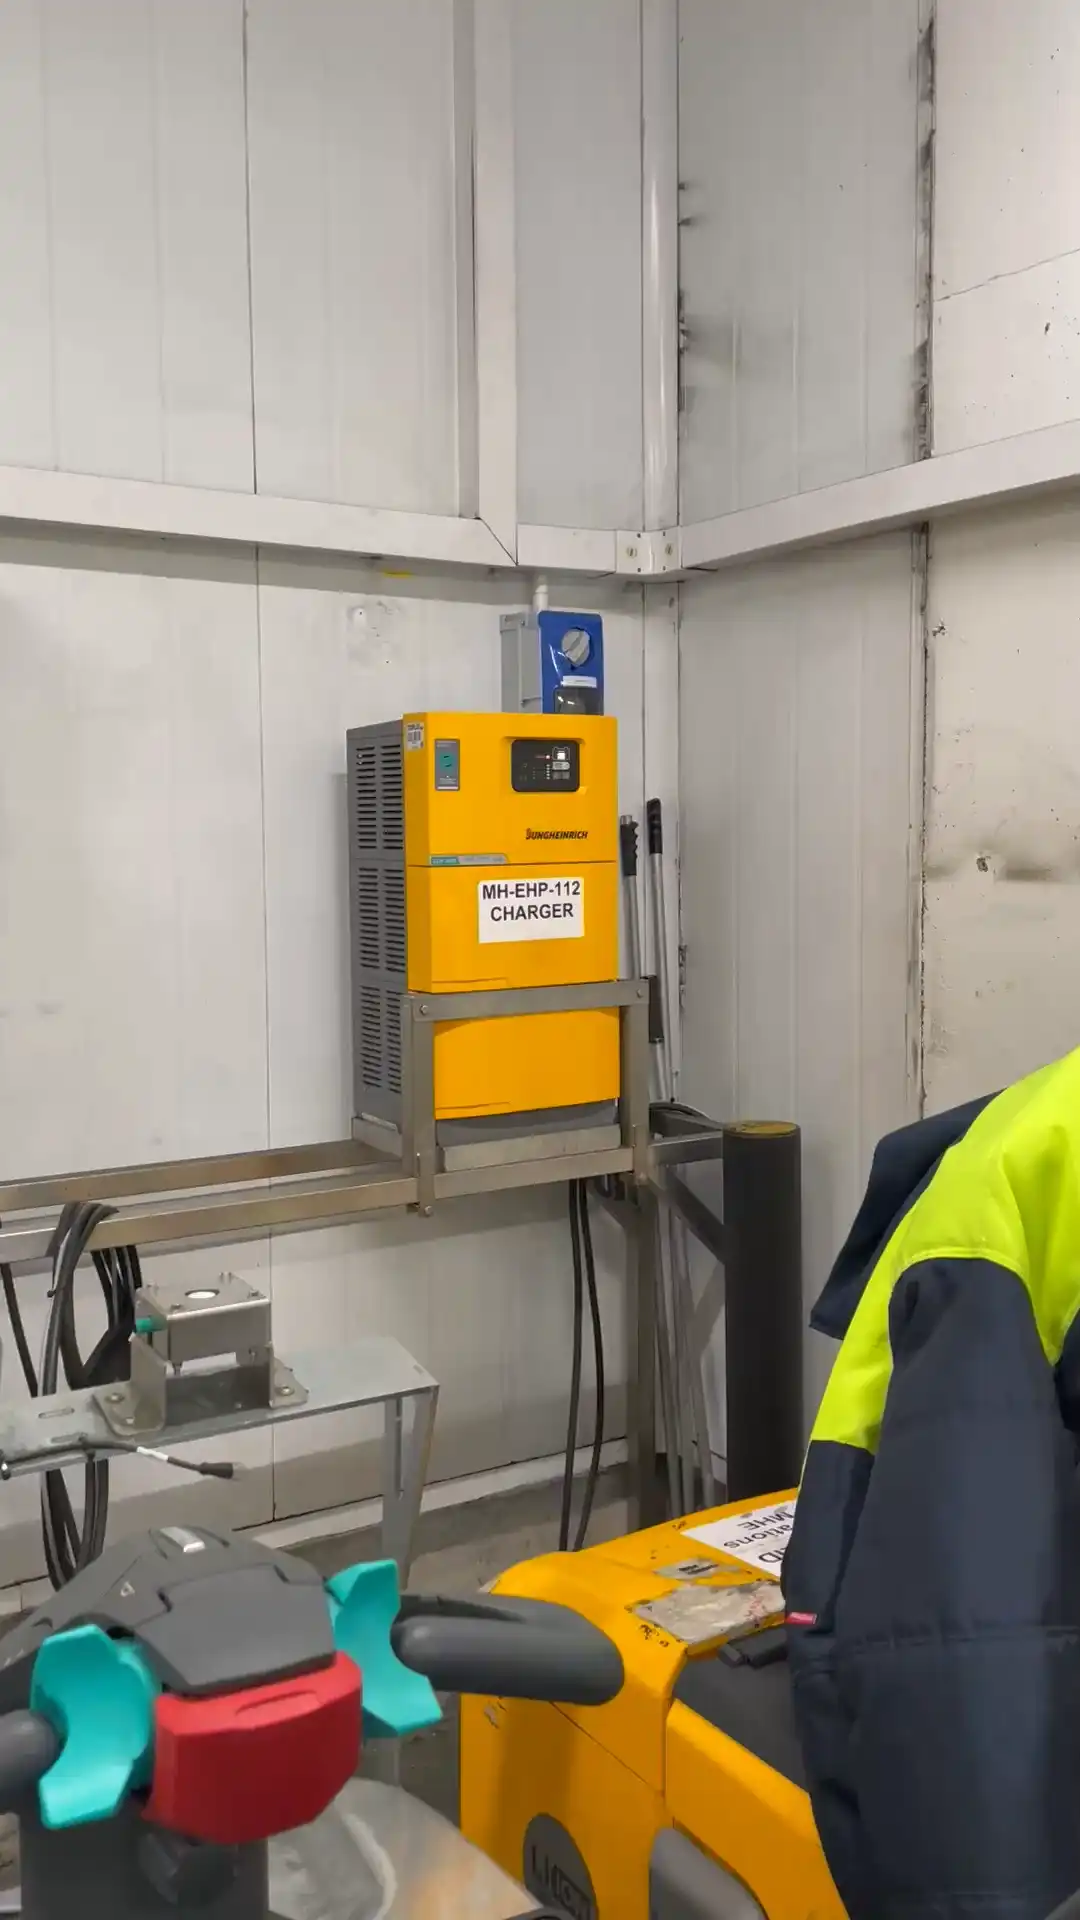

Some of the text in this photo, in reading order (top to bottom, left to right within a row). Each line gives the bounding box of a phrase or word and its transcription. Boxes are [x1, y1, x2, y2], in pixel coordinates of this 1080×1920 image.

[525, 828, 588, 840] JUNGHEINRICH
[482, 880, 581, 900] MH-EHP-112
[490, 903, 574, 921] CHARGER
[723, 1524, 793, 1549] ations
